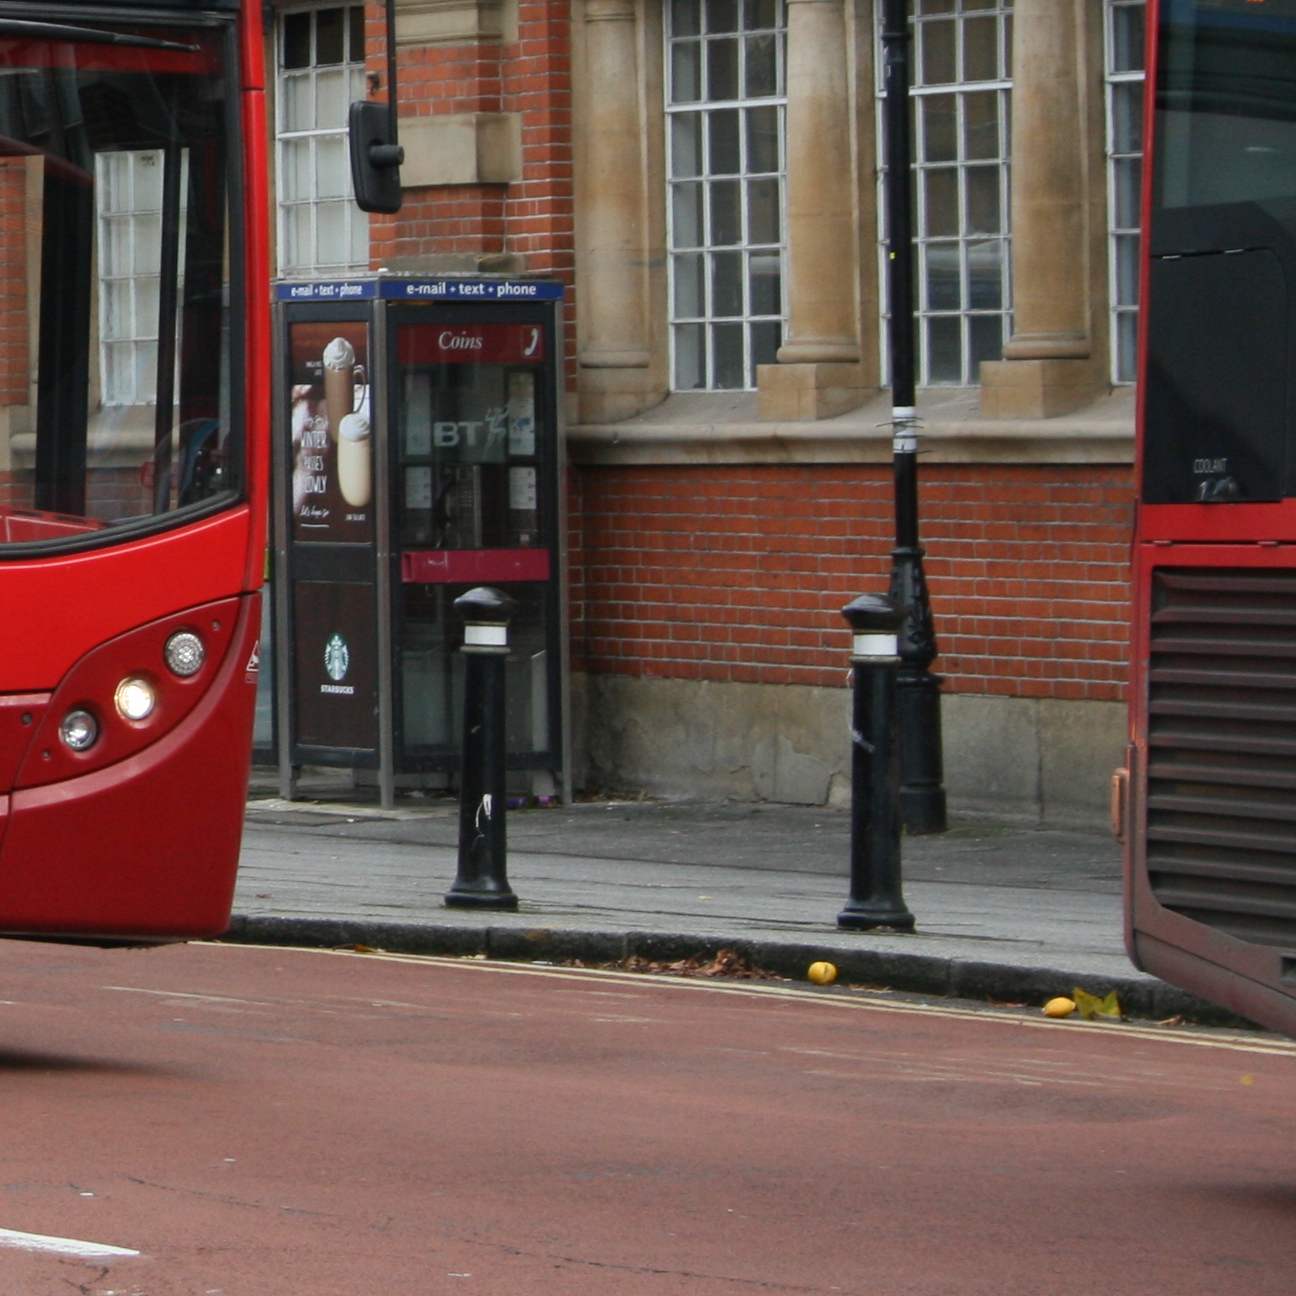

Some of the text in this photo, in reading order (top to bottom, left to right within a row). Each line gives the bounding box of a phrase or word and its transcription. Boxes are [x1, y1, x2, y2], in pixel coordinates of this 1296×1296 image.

[291, 283, 363, 298] e-mail text phone
[406, 282, 447, 296] e-mail
[458, 283, 486, 296] text
[496, 282, 538, 298] phone
[437, 330, 484, 351] Coins
[433, 421, 484, 447] BT
[320, 684, 355, 695] STARBUCKS
